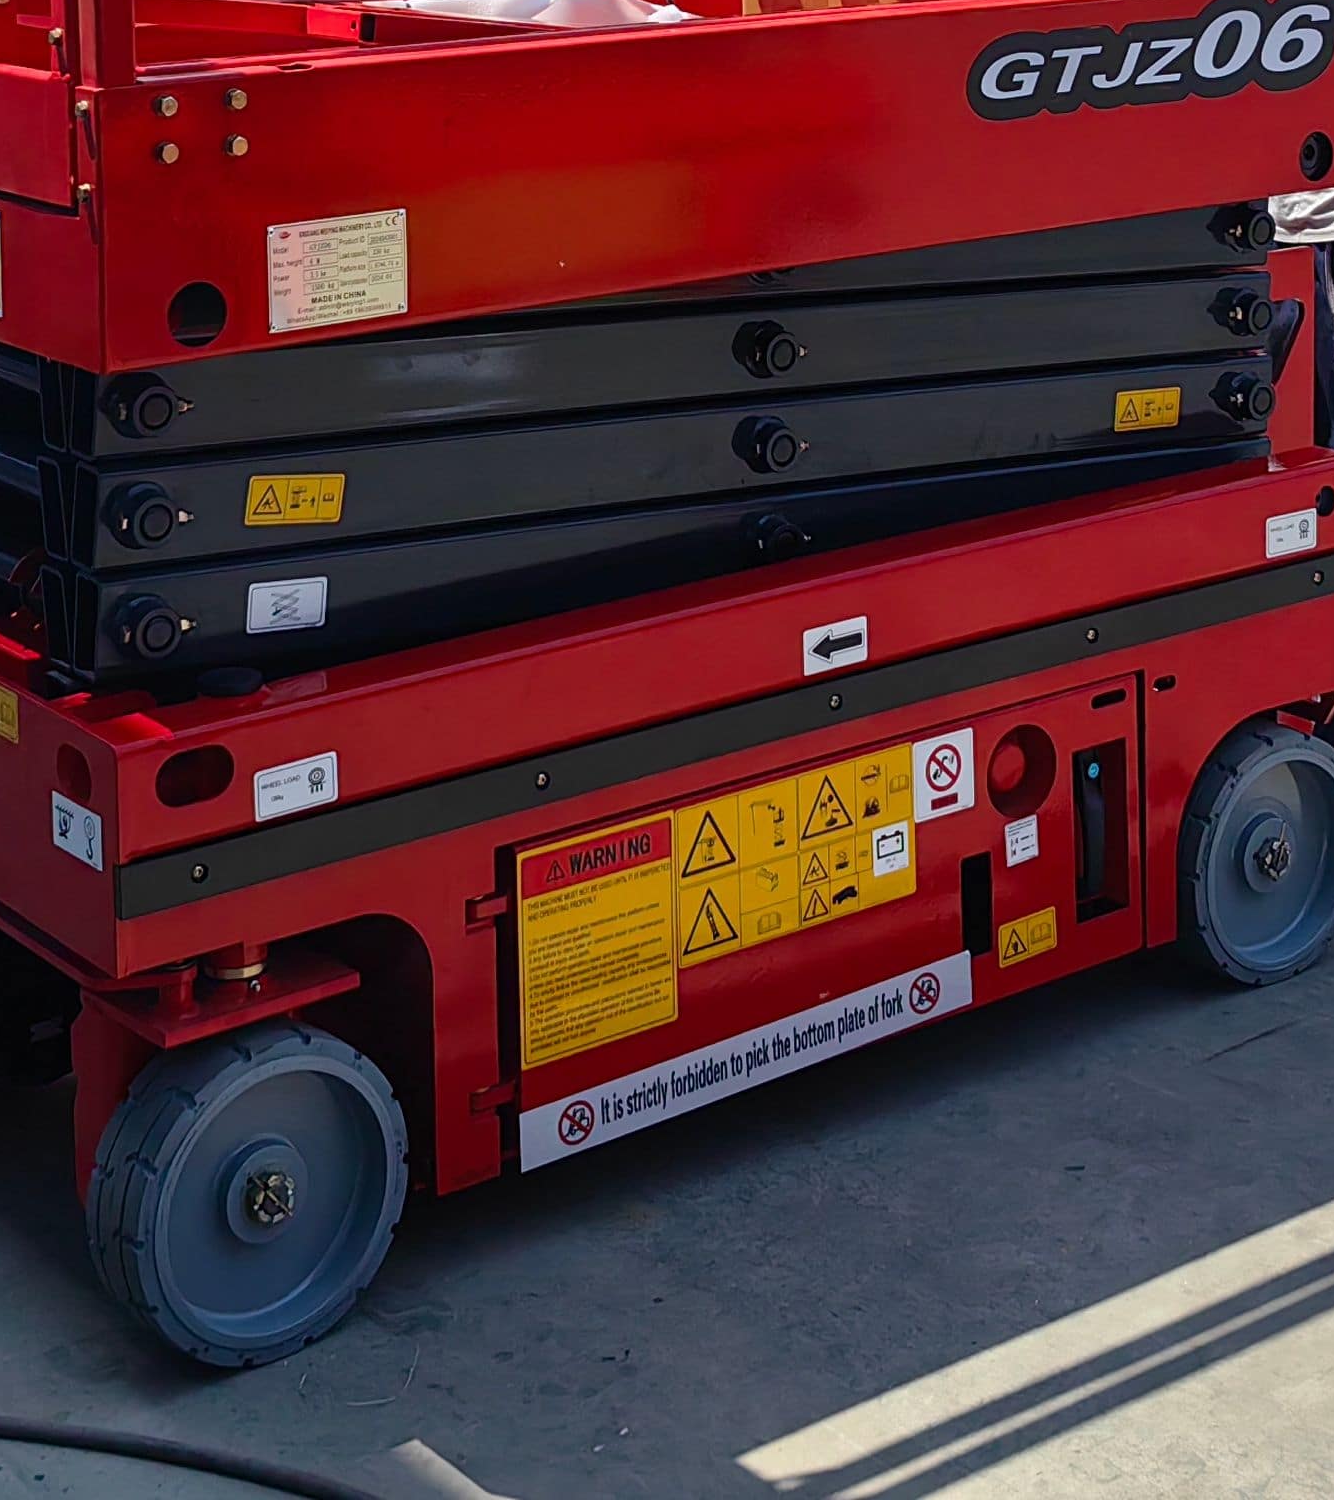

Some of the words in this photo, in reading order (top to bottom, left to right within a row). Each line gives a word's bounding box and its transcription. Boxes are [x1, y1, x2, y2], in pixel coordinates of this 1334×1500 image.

[979, 3, 1331, 100] GTJZ06
[311, 295, 333, 304] MADE
[343, 290, 366, 299] CHINA
[570, 833, 651, 876] WARNING
[600, 1096, 611, 1125] It
[613, 1092, 624, 1122] is
[626, 1079, 668, 1117] strictly
[671, 1060, 728, 1098] forbidden
[730, 1056, 744, 1077] to
[746, 1039, 769, 1078] pick
[772, 1035, 791, 1060] the
[793, 1025, 835, 1053] bottom
[837, 1005, 866, 1045] plate
[868, 996, 879, 1025] of
[881, 988, 904, 1021] fork
